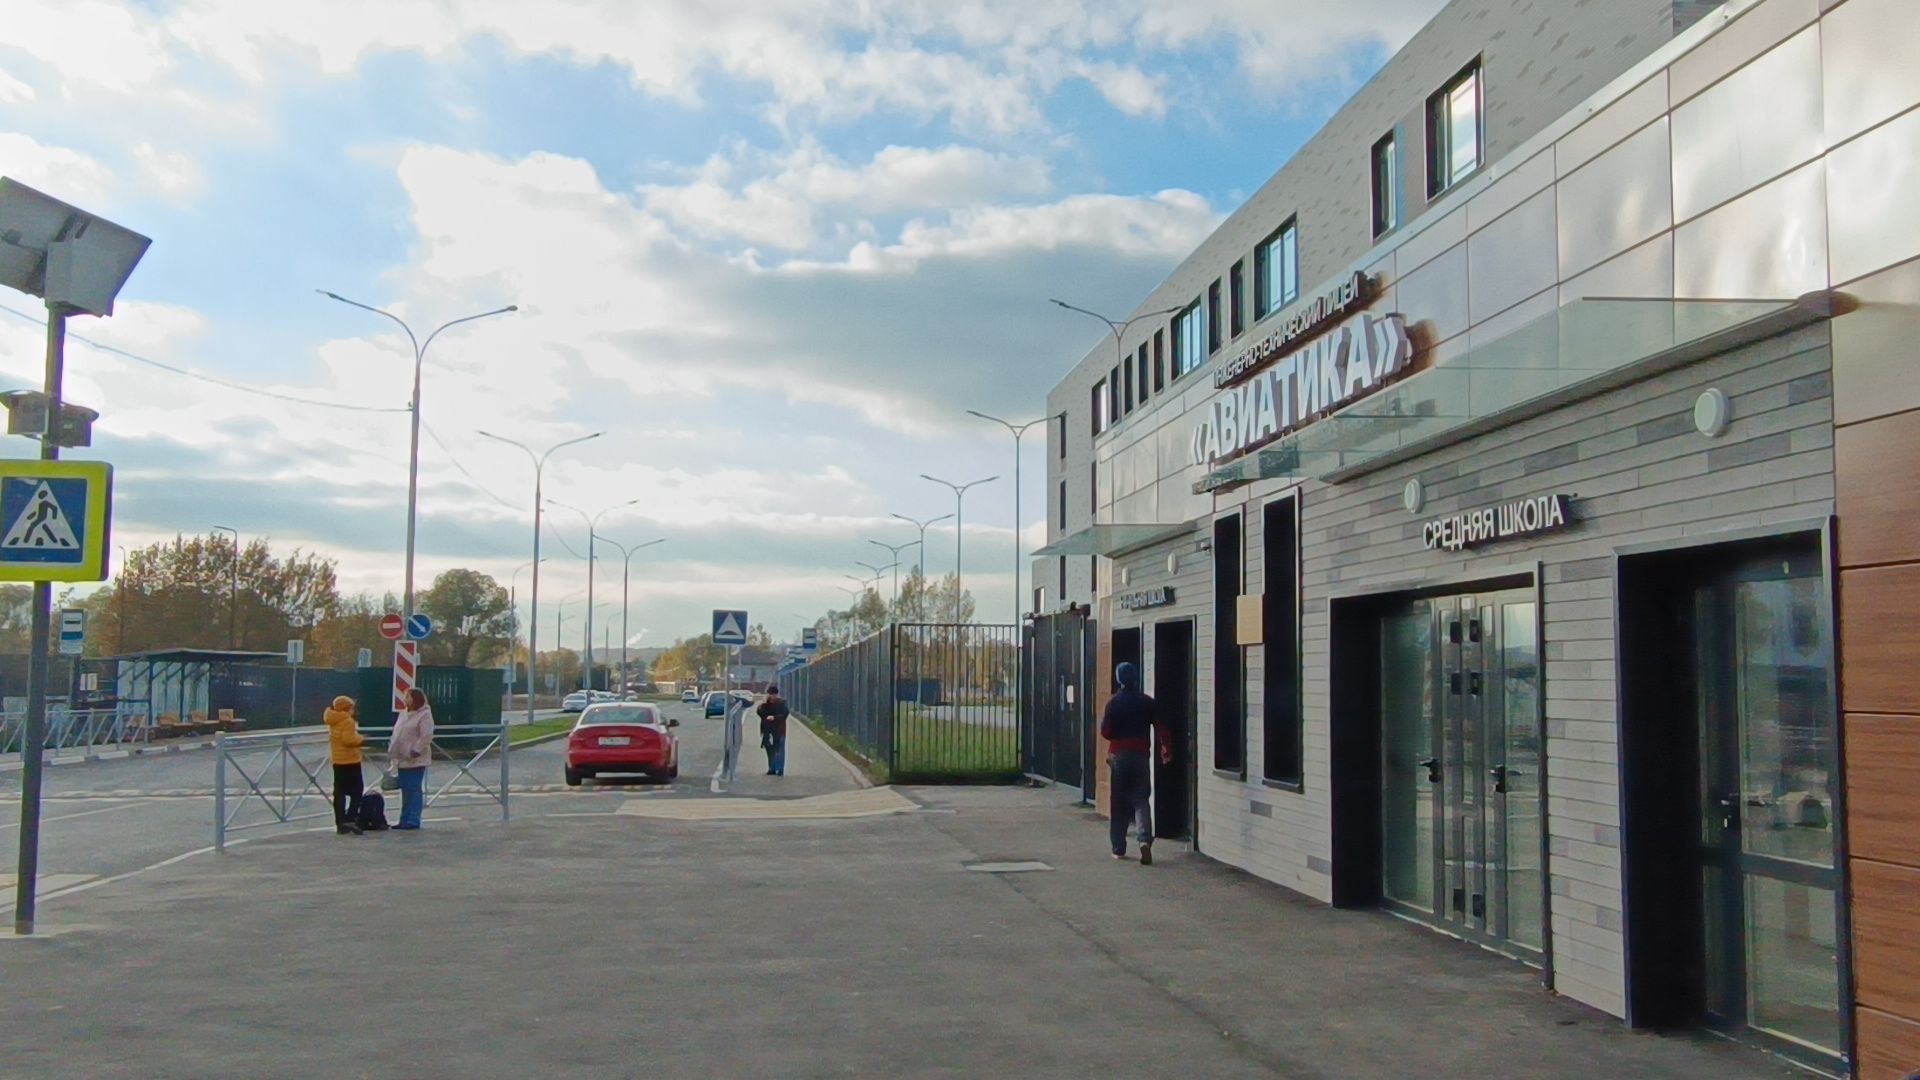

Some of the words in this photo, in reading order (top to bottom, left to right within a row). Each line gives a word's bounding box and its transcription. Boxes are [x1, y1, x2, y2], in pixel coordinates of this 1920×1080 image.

[1192, 314, 1402, 464] «АВИАТИКА»
[1423, 508, 1495, 551] СРЕДНЯЯ
[1498, 494, 1564, 537] ШКОЛА
